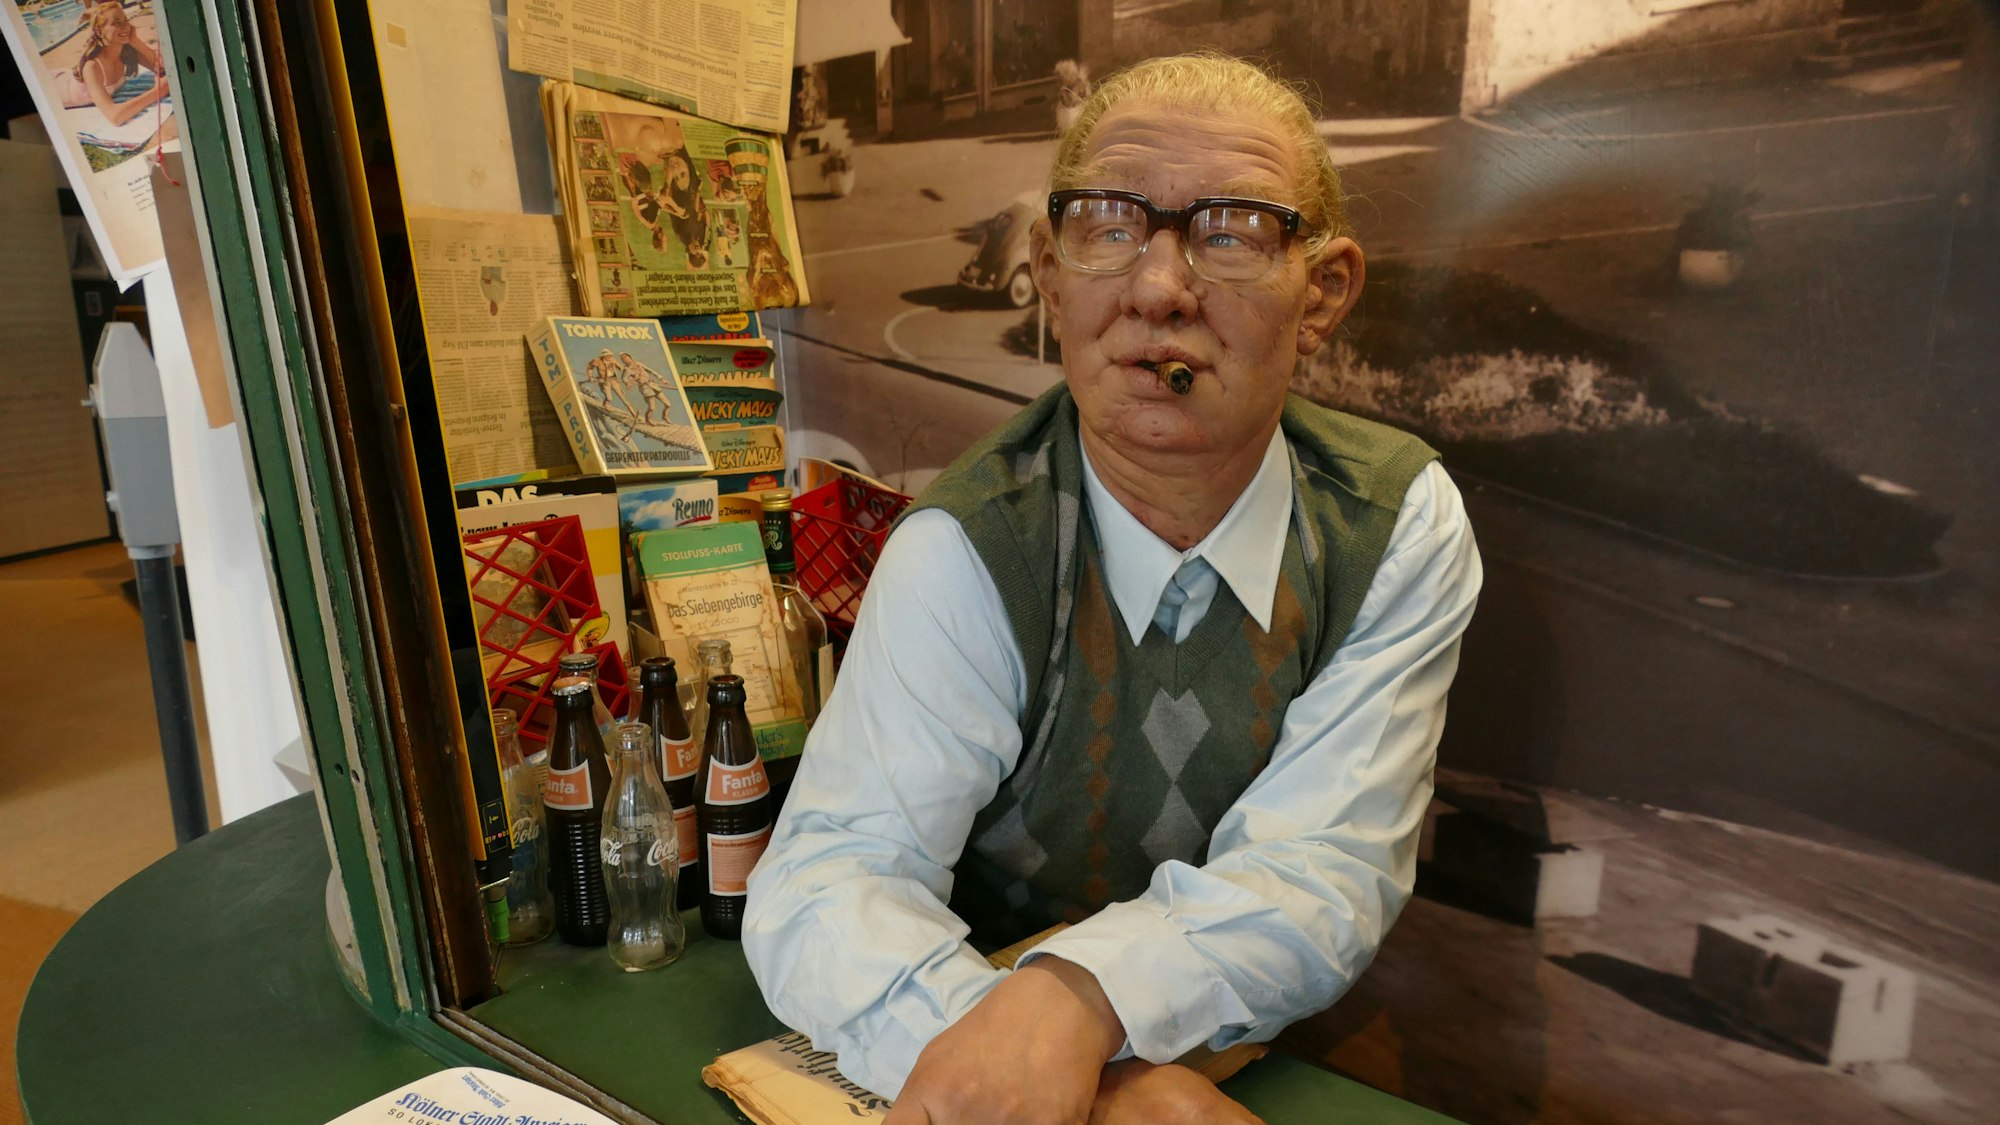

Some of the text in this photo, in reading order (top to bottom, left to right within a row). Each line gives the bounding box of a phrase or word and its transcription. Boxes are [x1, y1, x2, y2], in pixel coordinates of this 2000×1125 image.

[572, 22, 601, 38] werden
[724, 284, 737, 294] Das
[638, 296, 679, 308] geschrieben!
[680, 297, 713, 308] Geschichte
[562, 323, 654, 340] TOM PROX
[538, 338, 561, 382] TOM
[690, 400, 777, 422] MICKY MAUS
[564, 402, 590, 459] PROX
[605, 450, 691, 463] GESPENSTERPATROUILLE
[743, 445, 780, 468] MAUS
[476, 485, 538, 508] DAS
[662, 542, 744, 562] STOLLFUSS-KARTE
[666, 592, 764, 618] Das Siebengebirge
[676, 746, 698, 769] Fan
[546, 778, 574, 794] anta
[722, 771, 763, 795] Fanta
[388, 1108, 404, 1119] SO
[395, 1092, 460, 1122] Kölner
